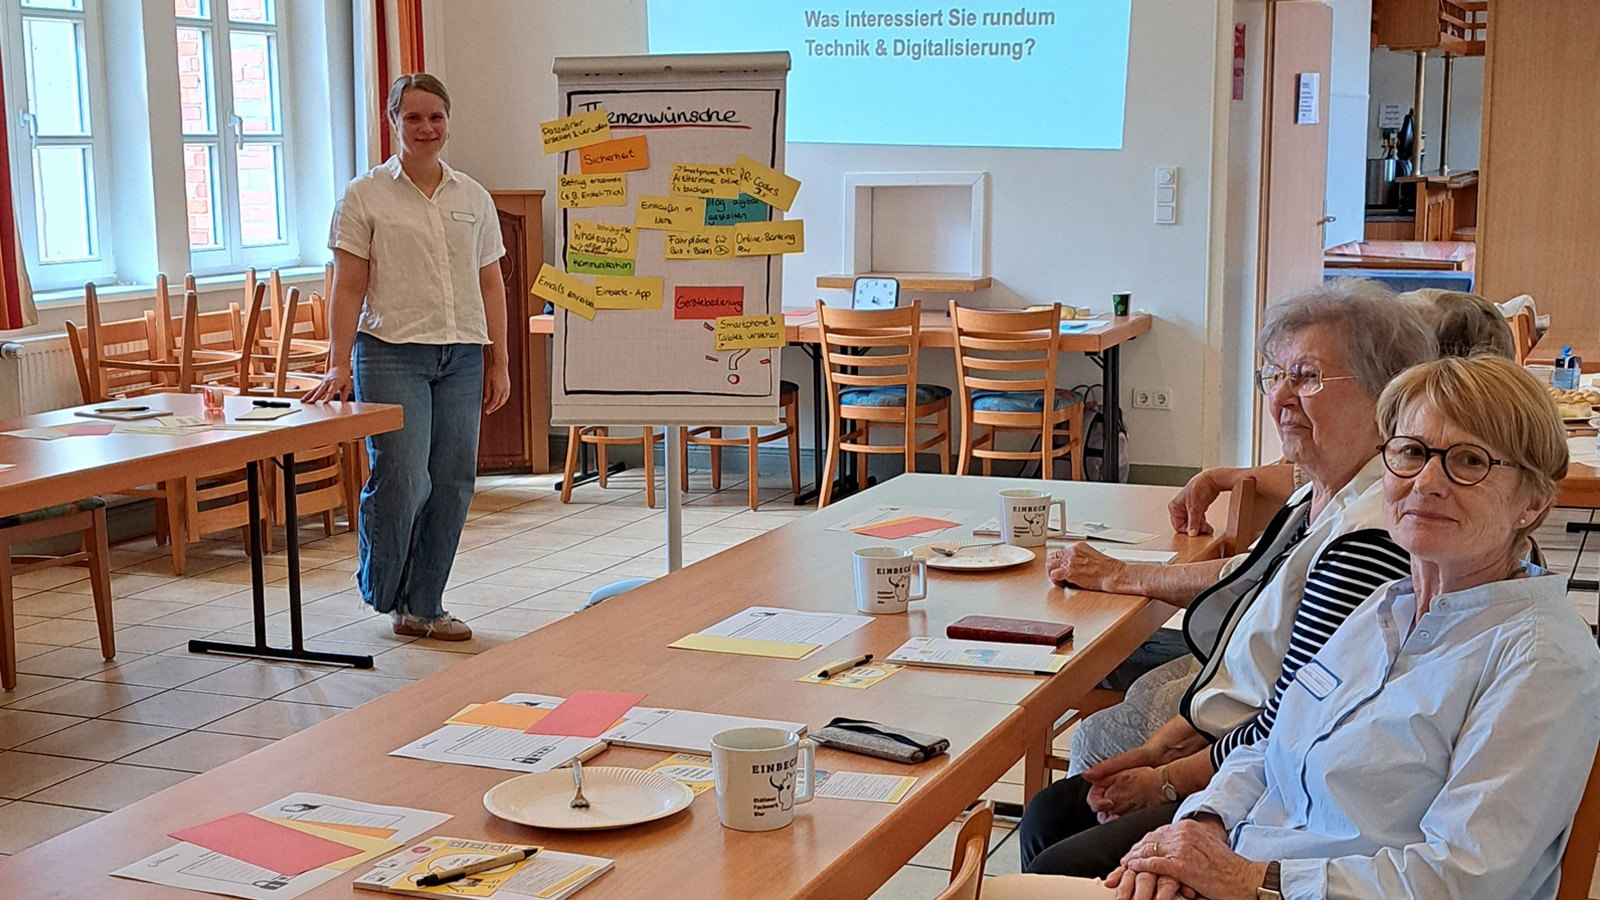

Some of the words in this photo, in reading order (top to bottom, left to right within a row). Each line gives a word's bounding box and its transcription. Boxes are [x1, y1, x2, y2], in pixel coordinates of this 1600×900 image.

[804, 10, 840, 28] Was
[845, 9, 944, 28] interessiert
[948, 8, 977, 27] Sie
[982, 7, 1056, 27] rundum
[804, 39, 870, 57] Technik
[874, 38, 888, 57] &
[892, 37, 1036, 61] Digitalisierung?
[578, 100, 742, 125] Temenwünsche
[583, 148, 636, 165] Sicherheit
[667, 234, 710, 246] Fahrpläne
[735, 231, 796, 246] Online-Banking
[669, 246, 683, 256] Bus
[537, 275, 566, 296] Emails
[675, 295, 743, 313] Gerätebedienung
[719, 318, 769, 330] Smartphone
[1012, 505, 1047, 513] EINBECK
